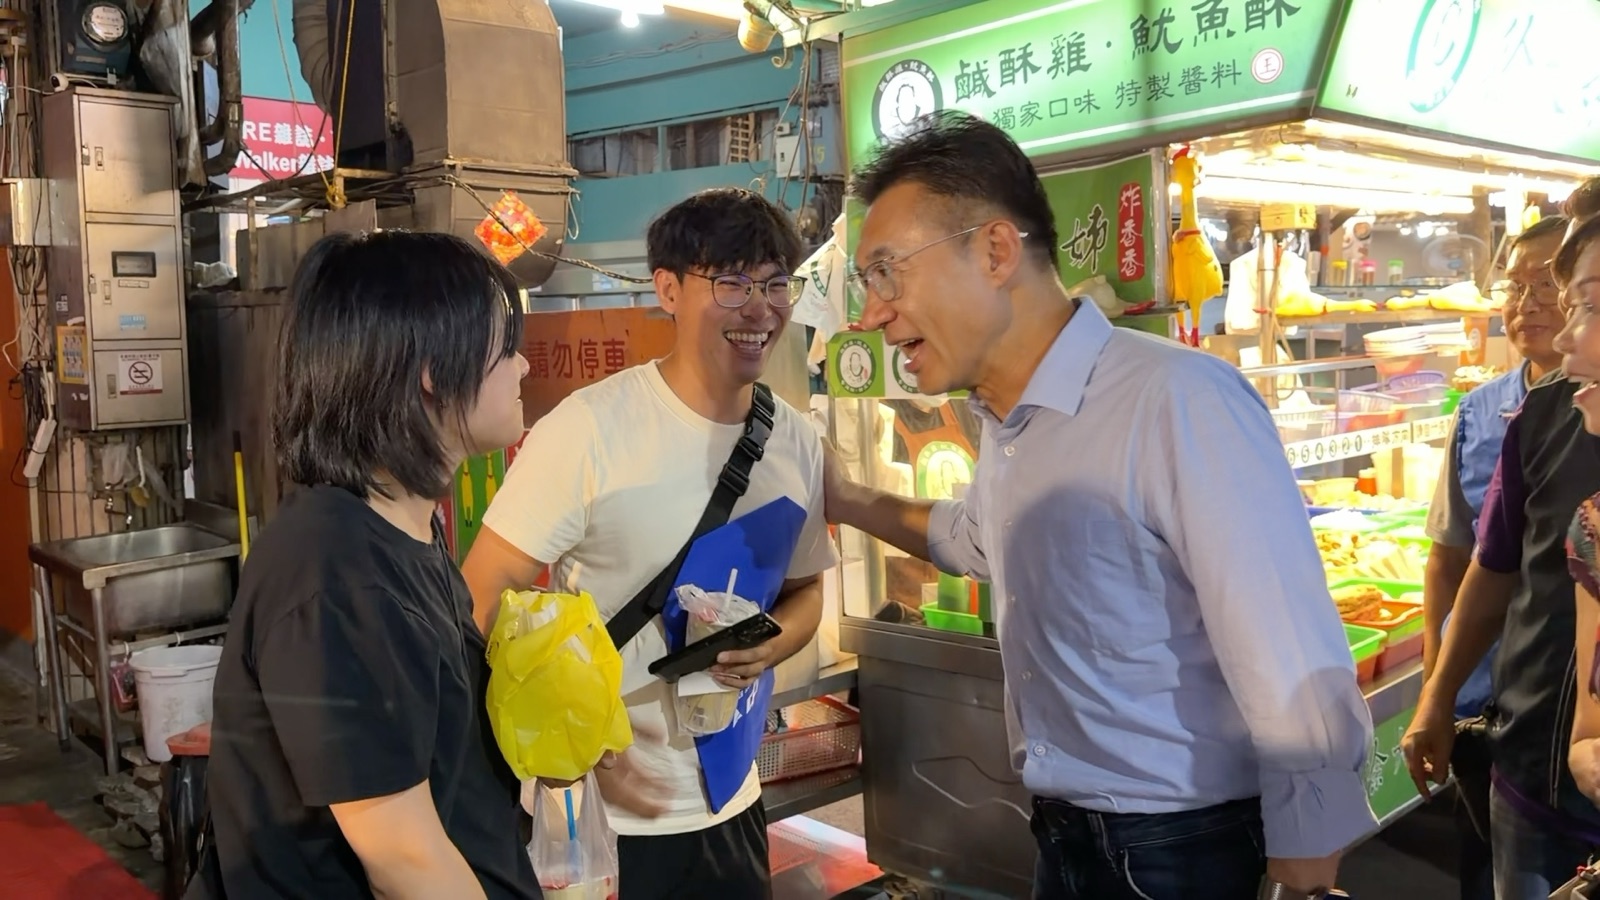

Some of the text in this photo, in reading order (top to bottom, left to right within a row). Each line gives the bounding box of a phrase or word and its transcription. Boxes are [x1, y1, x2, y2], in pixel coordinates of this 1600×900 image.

[992, 59, 1242, 130] 獨家口味 特製醬料
[1120, 184, 1144, 277] 炸香香
[527, 338, 625, 379] 請勿停車
